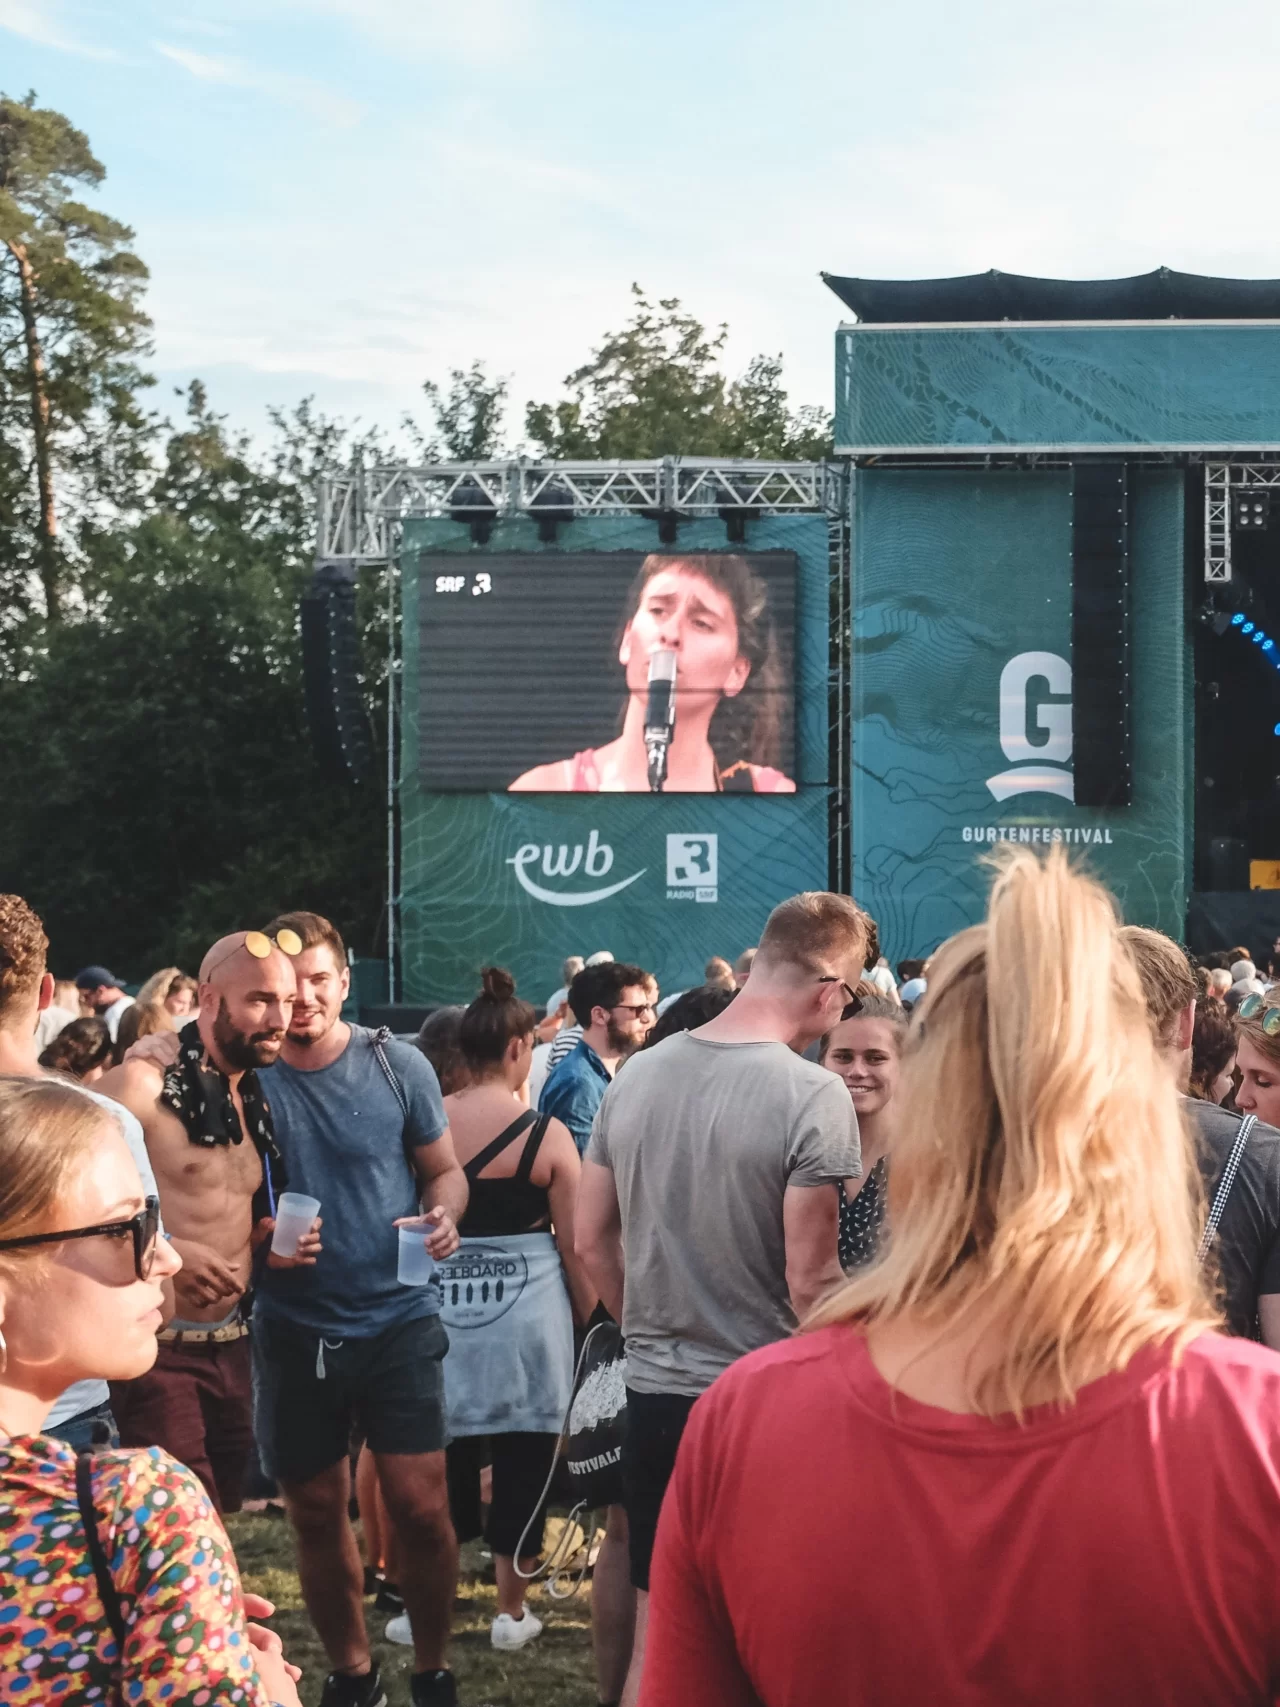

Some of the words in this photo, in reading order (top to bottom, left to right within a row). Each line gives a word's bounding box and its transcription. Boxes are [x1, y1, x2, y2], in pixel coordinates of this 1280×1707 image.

[435, 576, 466, 593] SRF
[472, 572, 492, 596] 3
[1000, 651, 1074, 763] G
[962, 826, 1113, 844] GURTENFESTIVAL
[505, 828, 616, 879] ewb
[674, 840, 711, 881] 3
[666, 889, 695, 900] RADIO
